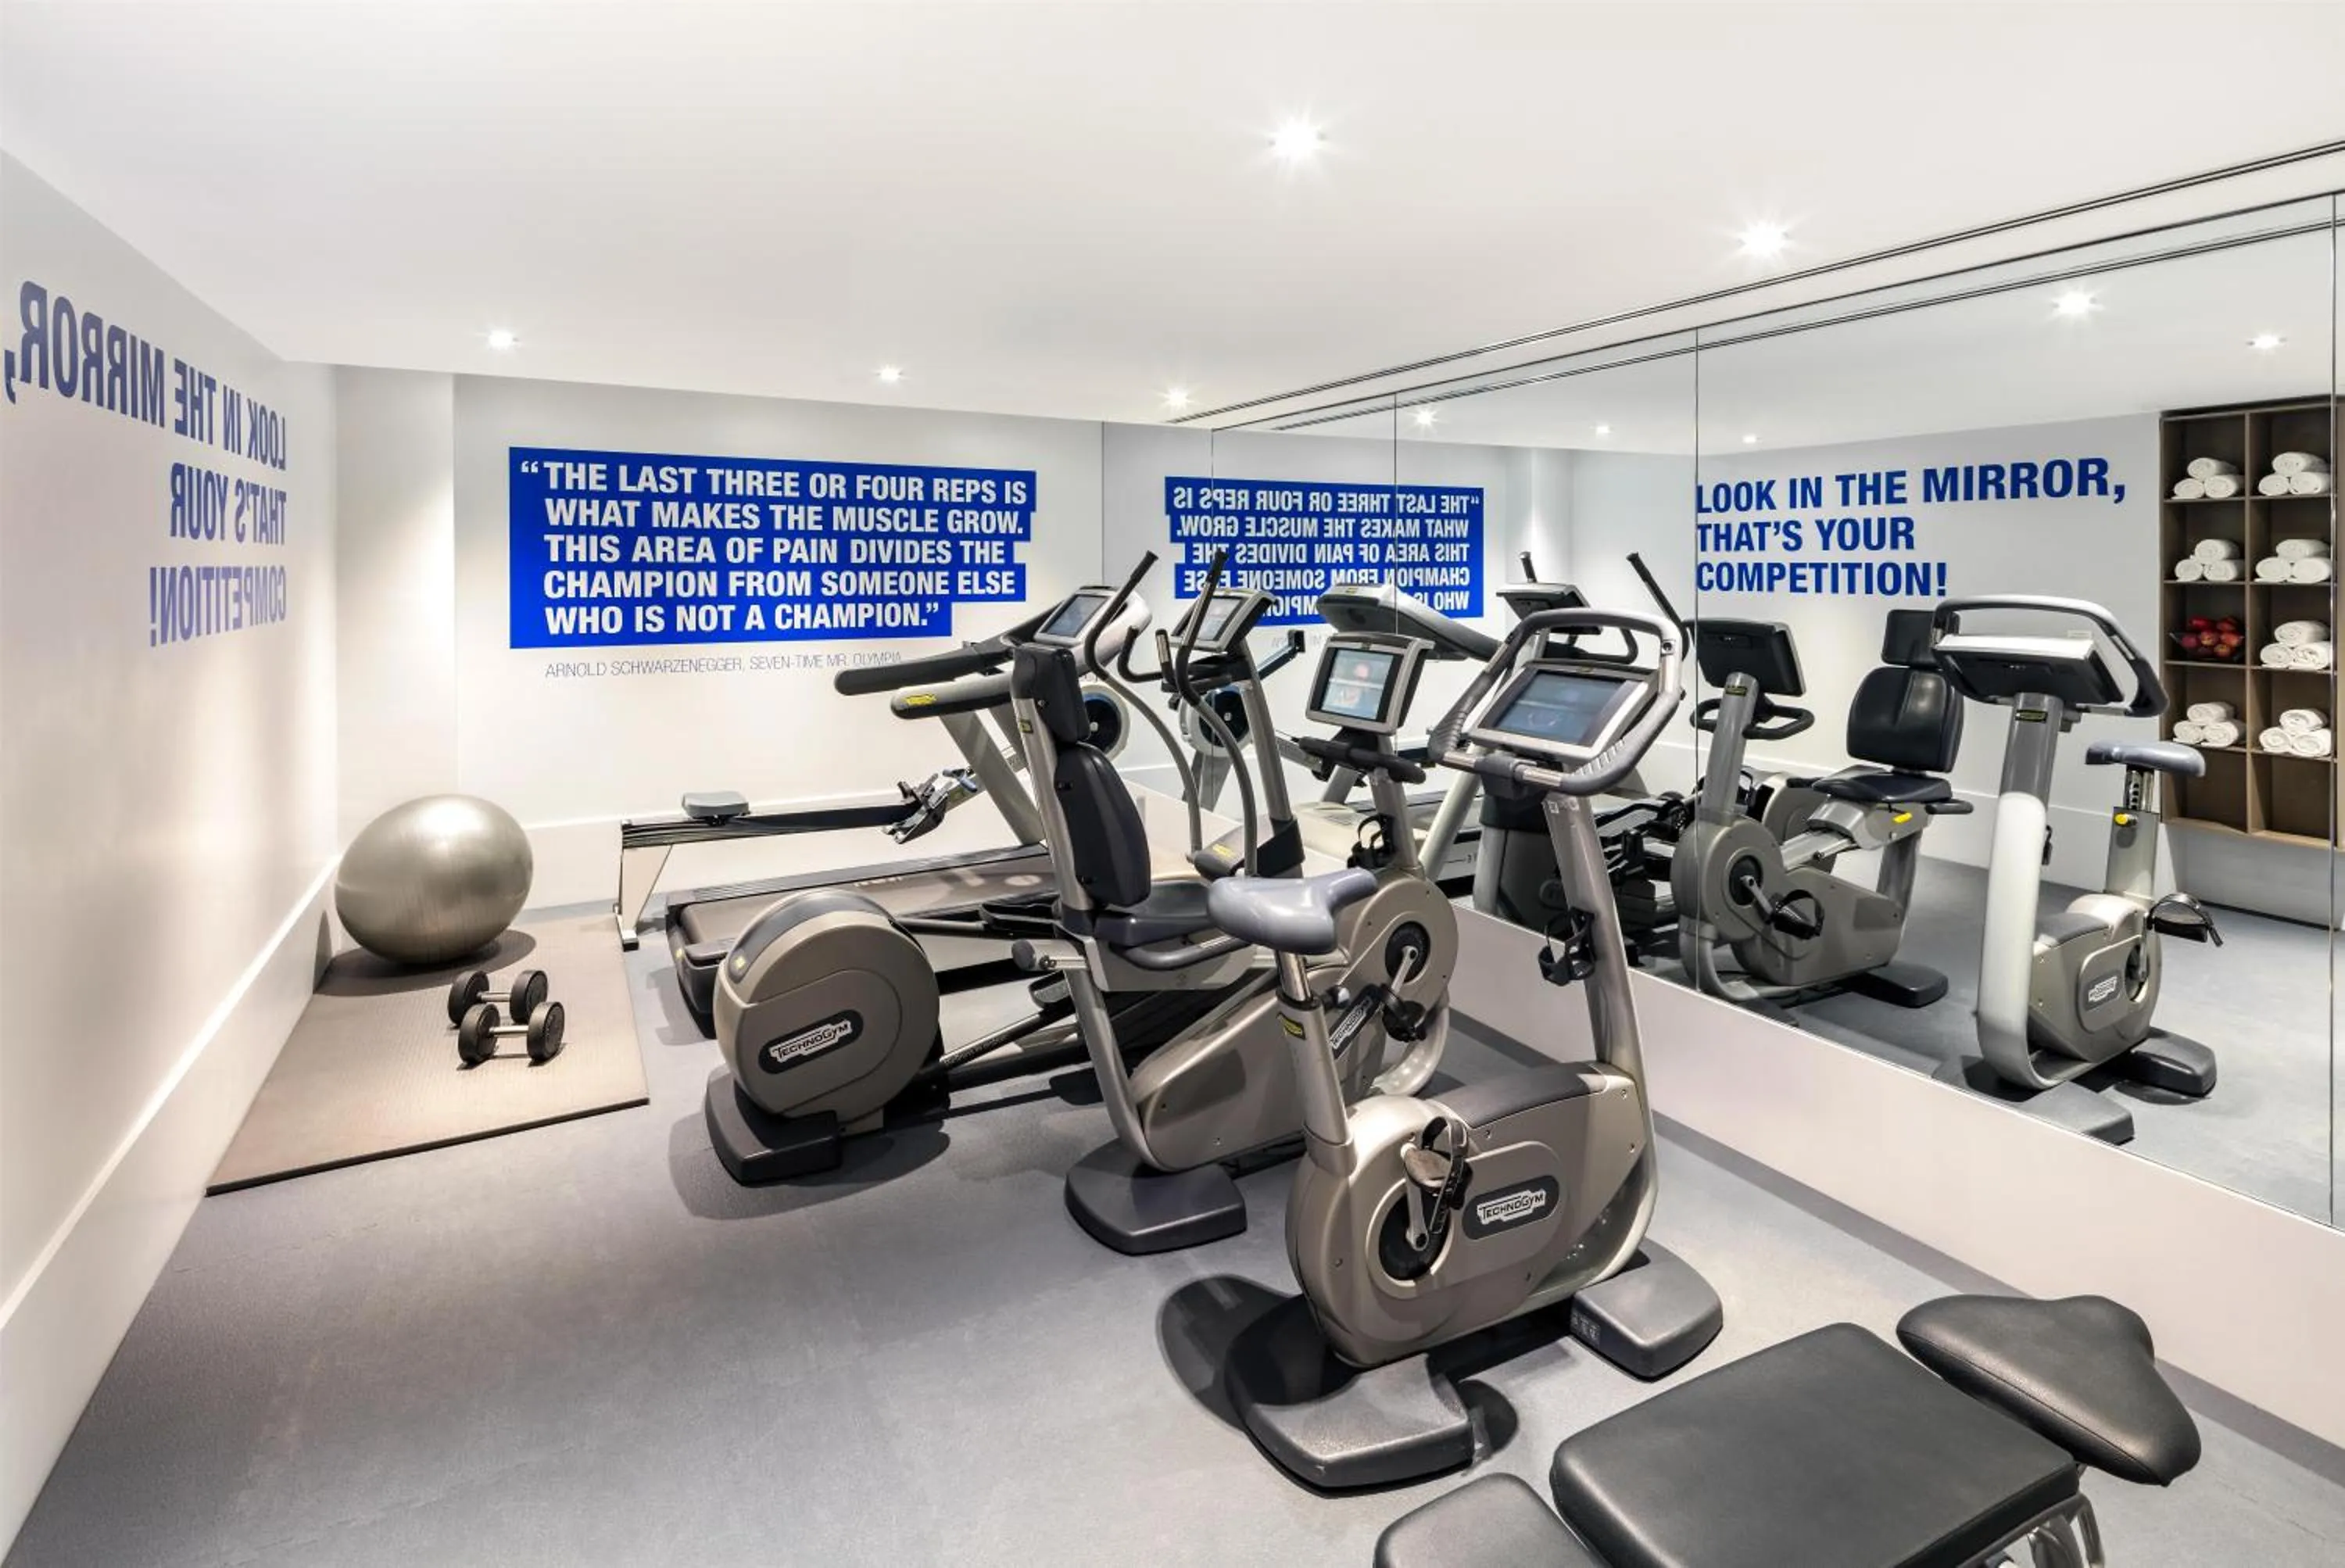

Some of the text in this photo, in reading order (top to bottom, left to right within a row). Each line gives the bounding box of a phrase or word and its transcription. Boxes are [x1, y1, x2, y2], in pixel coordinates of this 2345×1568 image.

[619, 465, 698, 494] LAST
[706, 469, 800, 497] THREE
[809, 474, 847, 499] OR
[856, 475, 924, 501] FOUR
[933, 478, 997, 503] REPS
[1004, 481, 1026, 504] IS
[1695, 457, 2126, 514] LOOK IN THE MIRROR,
[545, 499, 1023, 534] WHAT MAKES THE MUSCLE GROW.
[1814, 515, 1915, 552] YOUR
[544, 535, 1005, 564] THIS AREA OF PAIN DIVIDES THE
[543, 571, 1015, 599] CHAMPION FROM SOMEONE ELSE
[1695, 560, 1947, 598] COMPETITION!
[545, 607, 623, 635] WHO
[635, 606, 665, 632] IS
[676, 605, 736, 632] NOT
[744, 604, 765, 631] A
[545, 663, 607, 678] ARNOLD
[610, 659, 745, 677] SCHWARZENEGGER,
[749, 655, 824, 671] SEVEN-TIME
